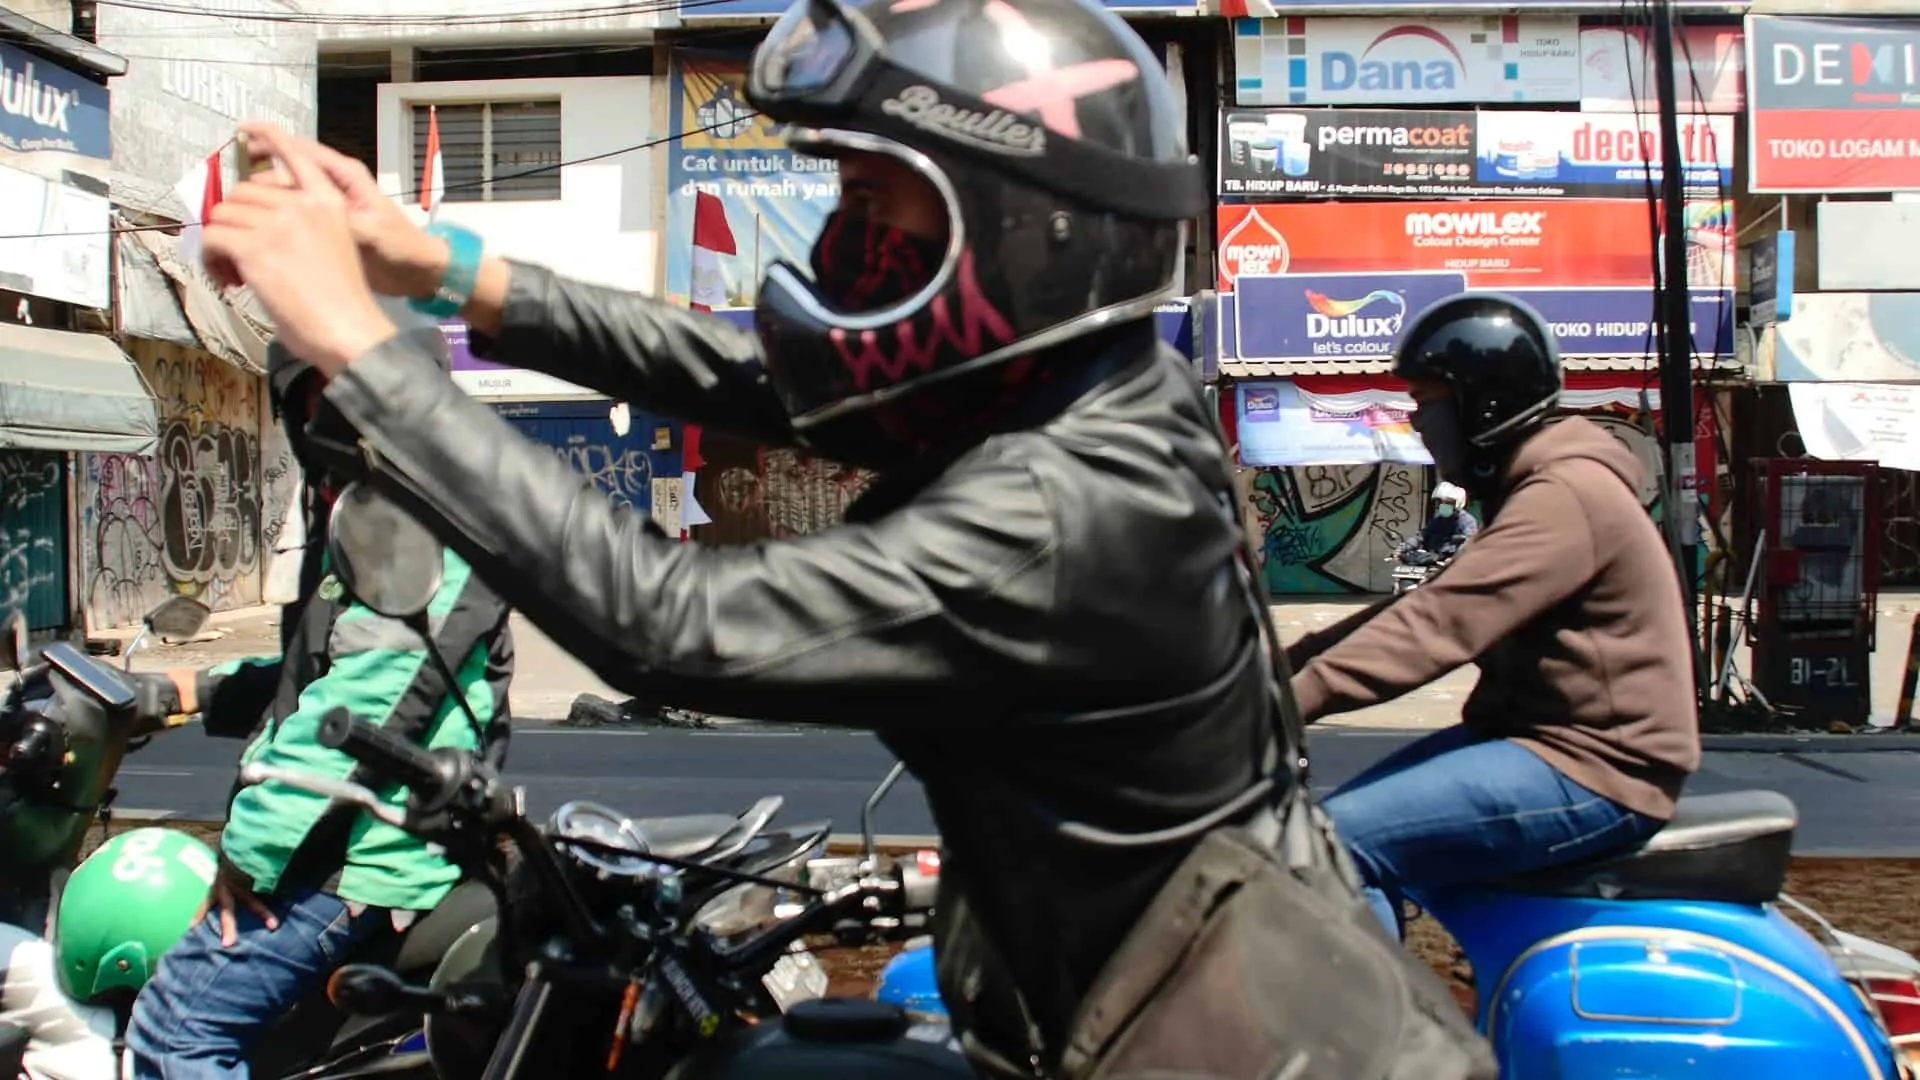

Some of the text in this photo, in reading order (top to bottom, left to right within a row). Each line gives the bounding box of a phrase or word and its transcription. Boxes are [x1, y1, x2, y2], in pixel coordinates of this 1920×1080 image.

[1321, 51, 1455, 91] Dana
[0, 57, 68, 133] ulux
[1318, 124, 1469, 150] permacoat
[1573, 121, 1717, 163] decoth
[1769, 138, 1825, 158] TOKO
[1829, 138, 1904, 158] LOGAM
[681, 154, 717, 171] Cat
[723, 153, 785, 171] untuk
[681, 179, 720, 195] dan
[726, 179, 796, 195] rumah
[1245, 180, 1285, 191] HIDUP
[1285, 180, 1319, 192] BARU
[1414, 235, 1541, 247] Colour Design Center
[1307, 313, 1397, 338] Dulux
[1548, 323, 1591, 336] TOKO
[1596, 323, 1647, 337] HIDUP
[1314, 342, 1390, 355] let's colour
